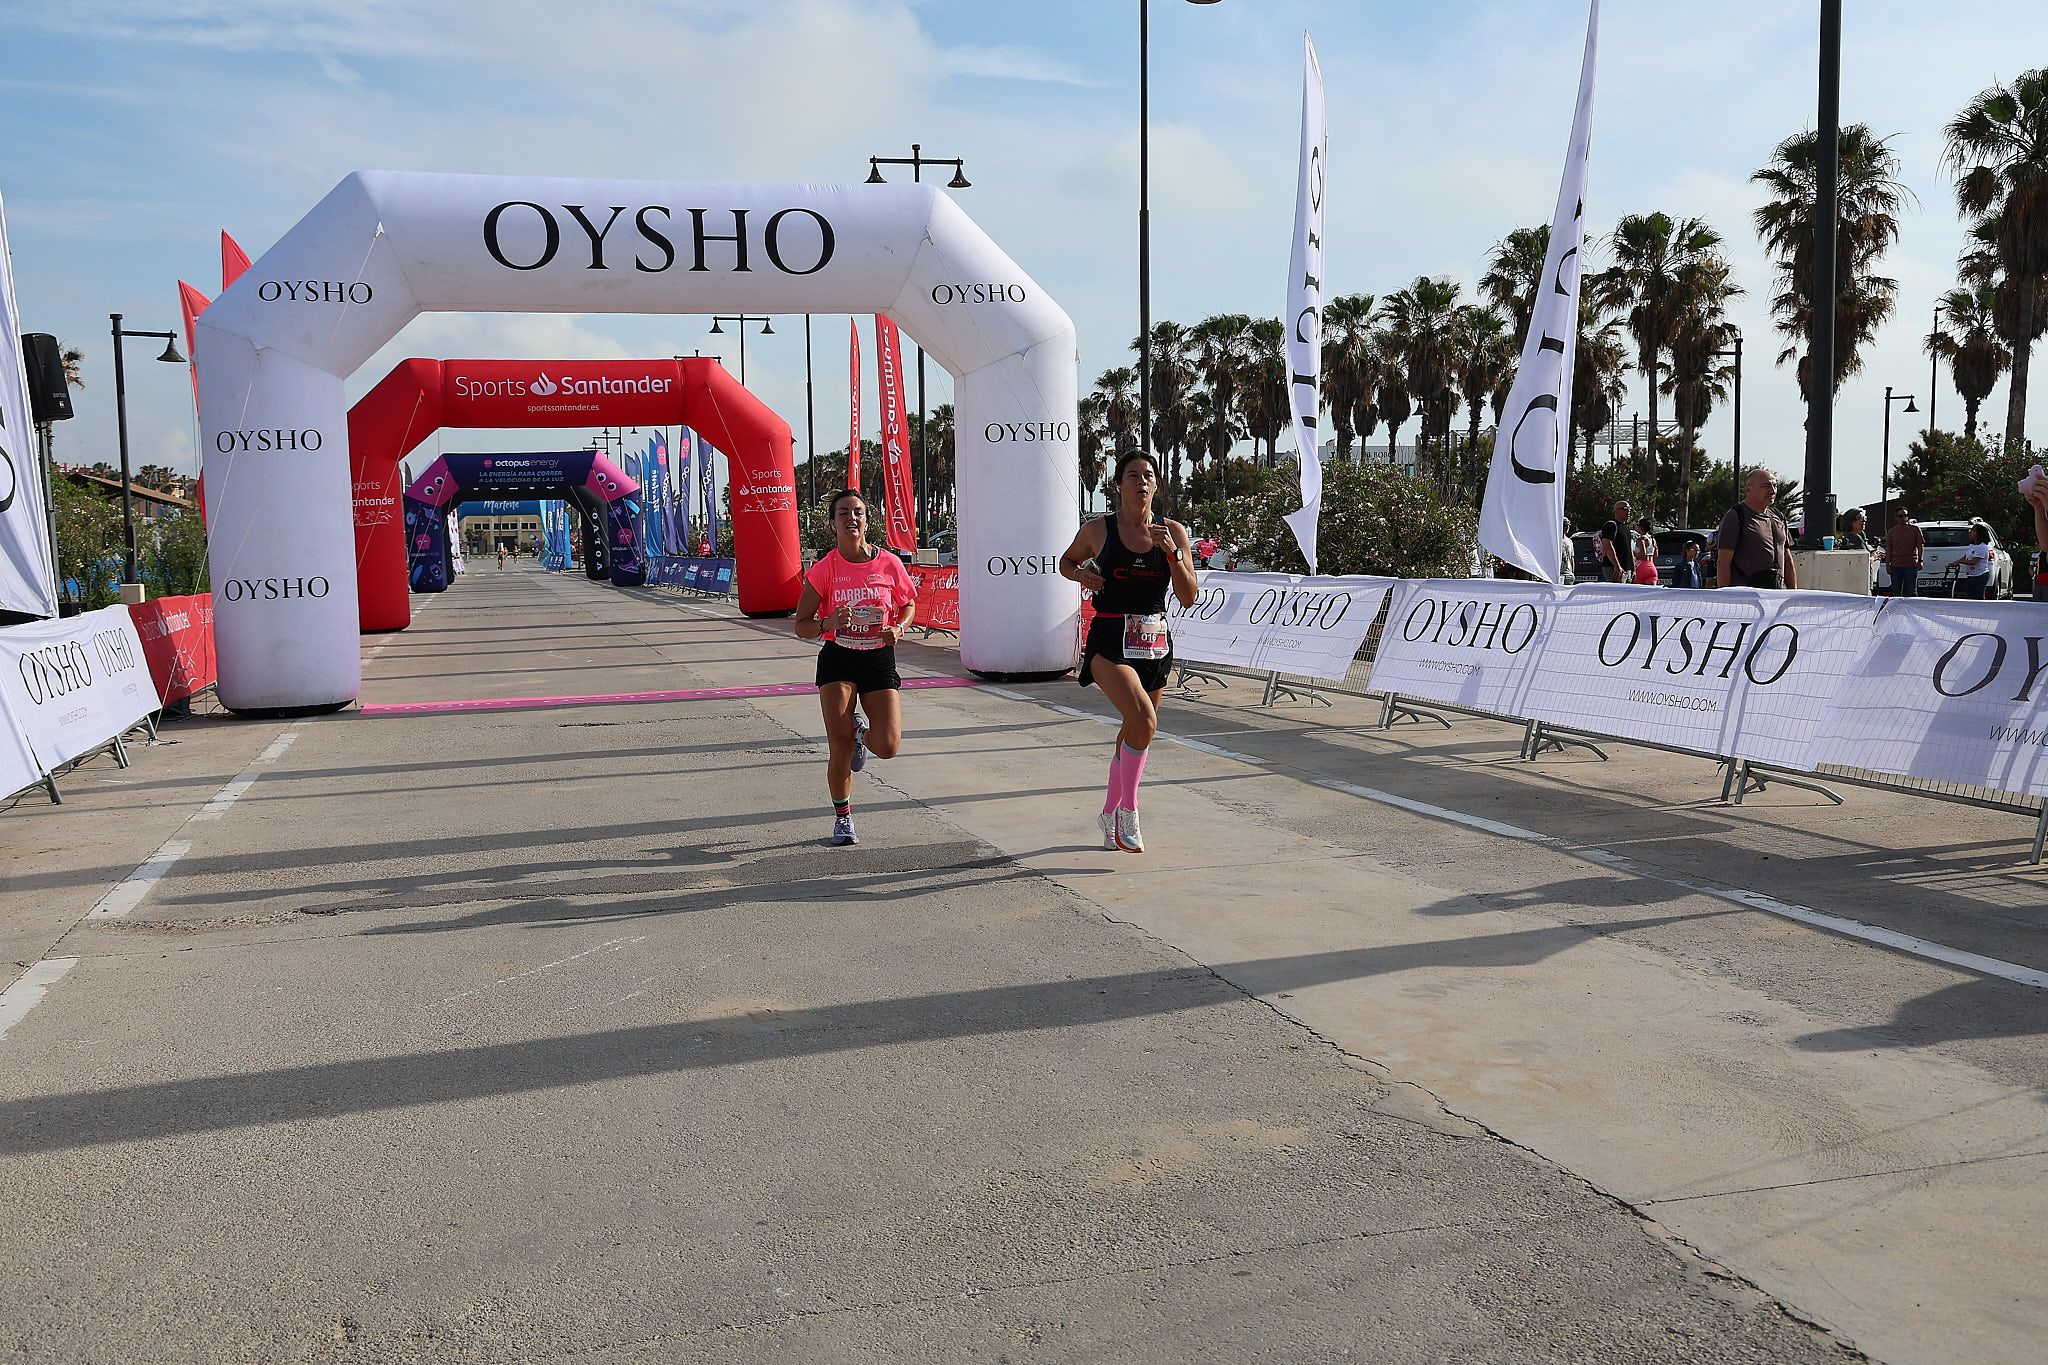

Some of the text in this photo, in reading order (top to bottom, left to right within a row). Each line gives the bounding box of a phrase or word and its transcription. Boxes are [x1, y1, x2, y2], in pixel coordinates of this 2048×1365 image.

[482, 200, 836, 276] OYSHO
[257, 279, 374, 306] OYSHO
[930, 283, 1027, 306] OYSHO
[455, 375, 672, 401] Sports Santander
[527, 403, 600, 414] sportssantander.es
[215, 428, 323, 454] OYSHO
[984, 421, 1072, 444] OYSHO
[495, 460, 530, 469] octopus
[751, 469, 782, 480] Sports
[353, 481, 381, 492] ports
[750, 485, 793, 495] Santander
[352, 496, 396, 507] antander
[987, 556, 1057, 577] OYSH
[224, 575, 330, 602] OYSHO
[1250, 588, 1352, 631] OYSHO
[851, 624, 869, 633] 016
[1141, 633, 1157, 642] 016
[1402, 597, 1539, 655] OYSHO
[94, 627, 135, 678] OYSHO
[1598, 610, 1800, 686] OYSHO
[18, 640, 92, 706] OYSHO
[1628, 689, 1718, 713] WWW.OYSHO.COM
